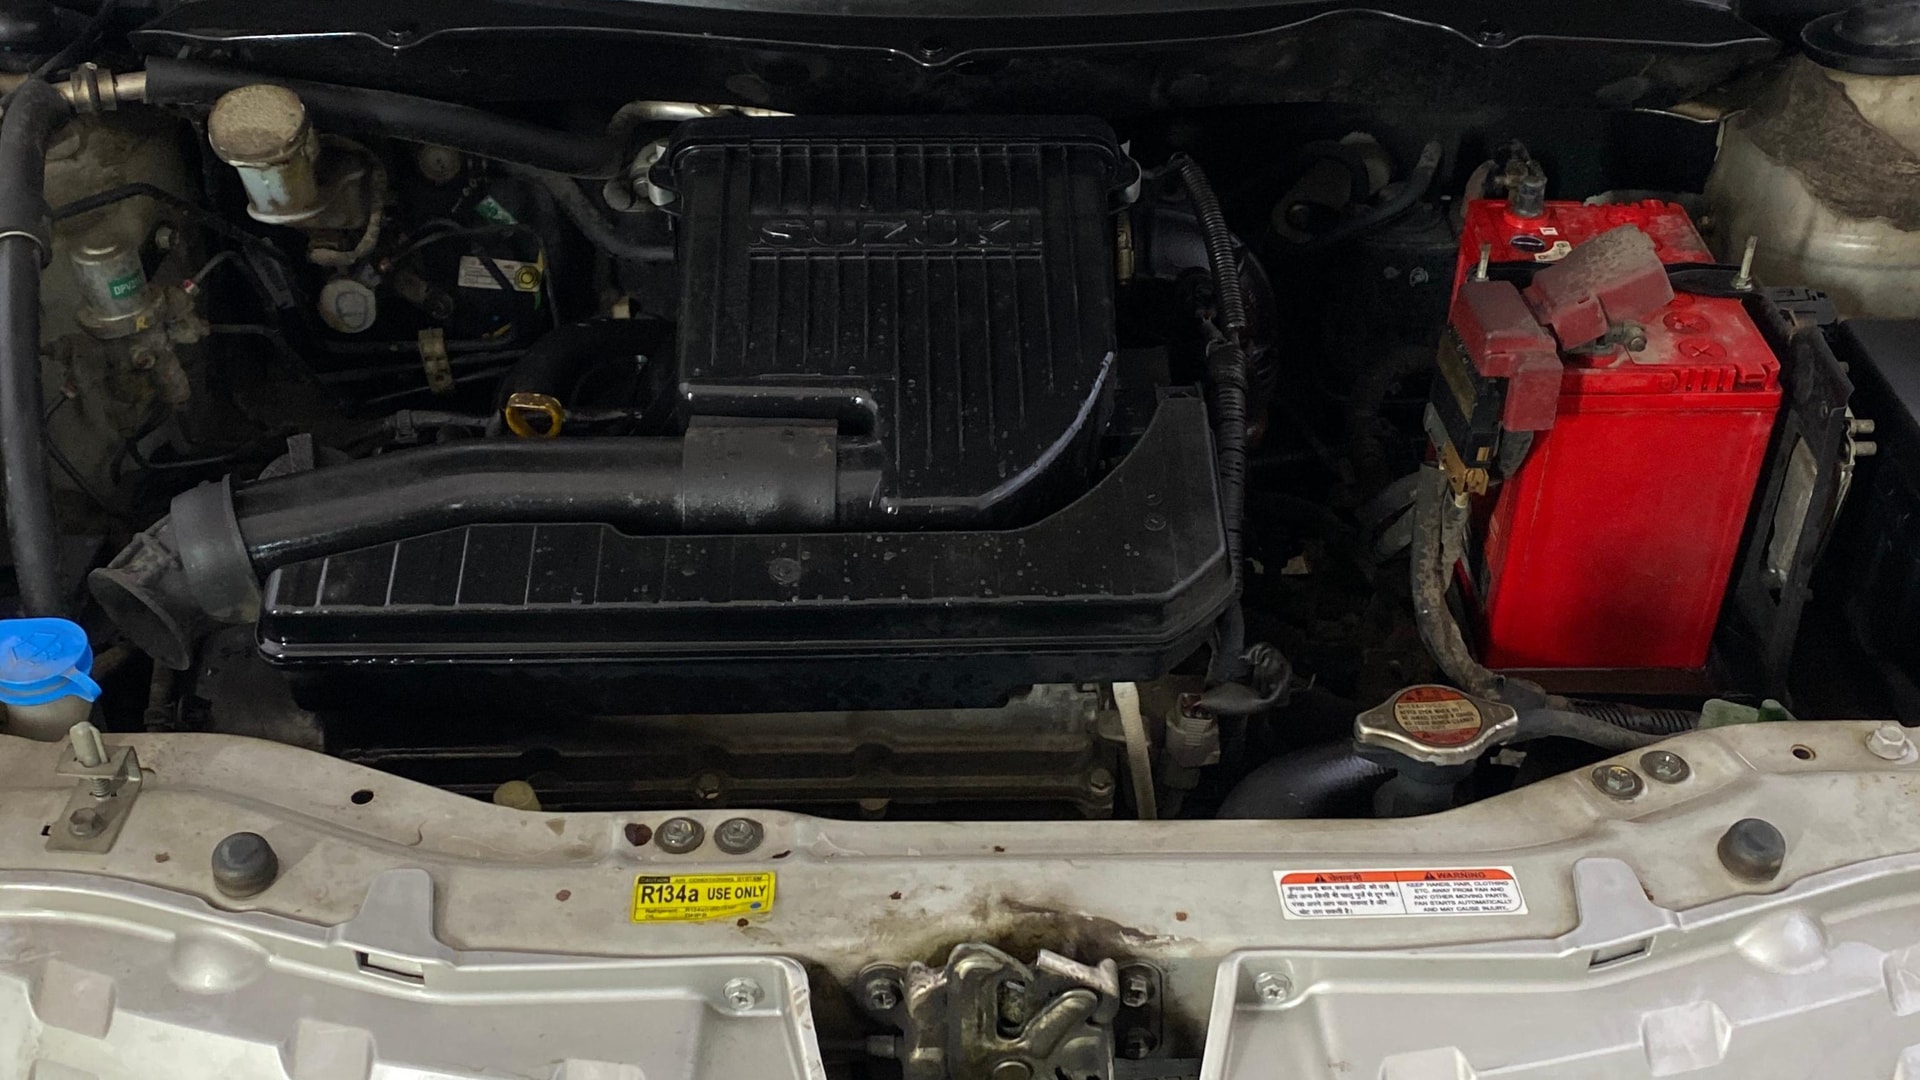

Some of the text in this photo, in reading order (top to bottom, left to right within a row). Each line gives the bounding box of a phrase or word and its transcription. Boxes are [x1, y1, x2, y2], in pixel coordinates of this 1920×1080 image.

[756, 218, 1042, 248] SUZUKI
[1436, 871, 1486, 879] WARNING
[641, 884, 766, 904] R134a USE ONLY
